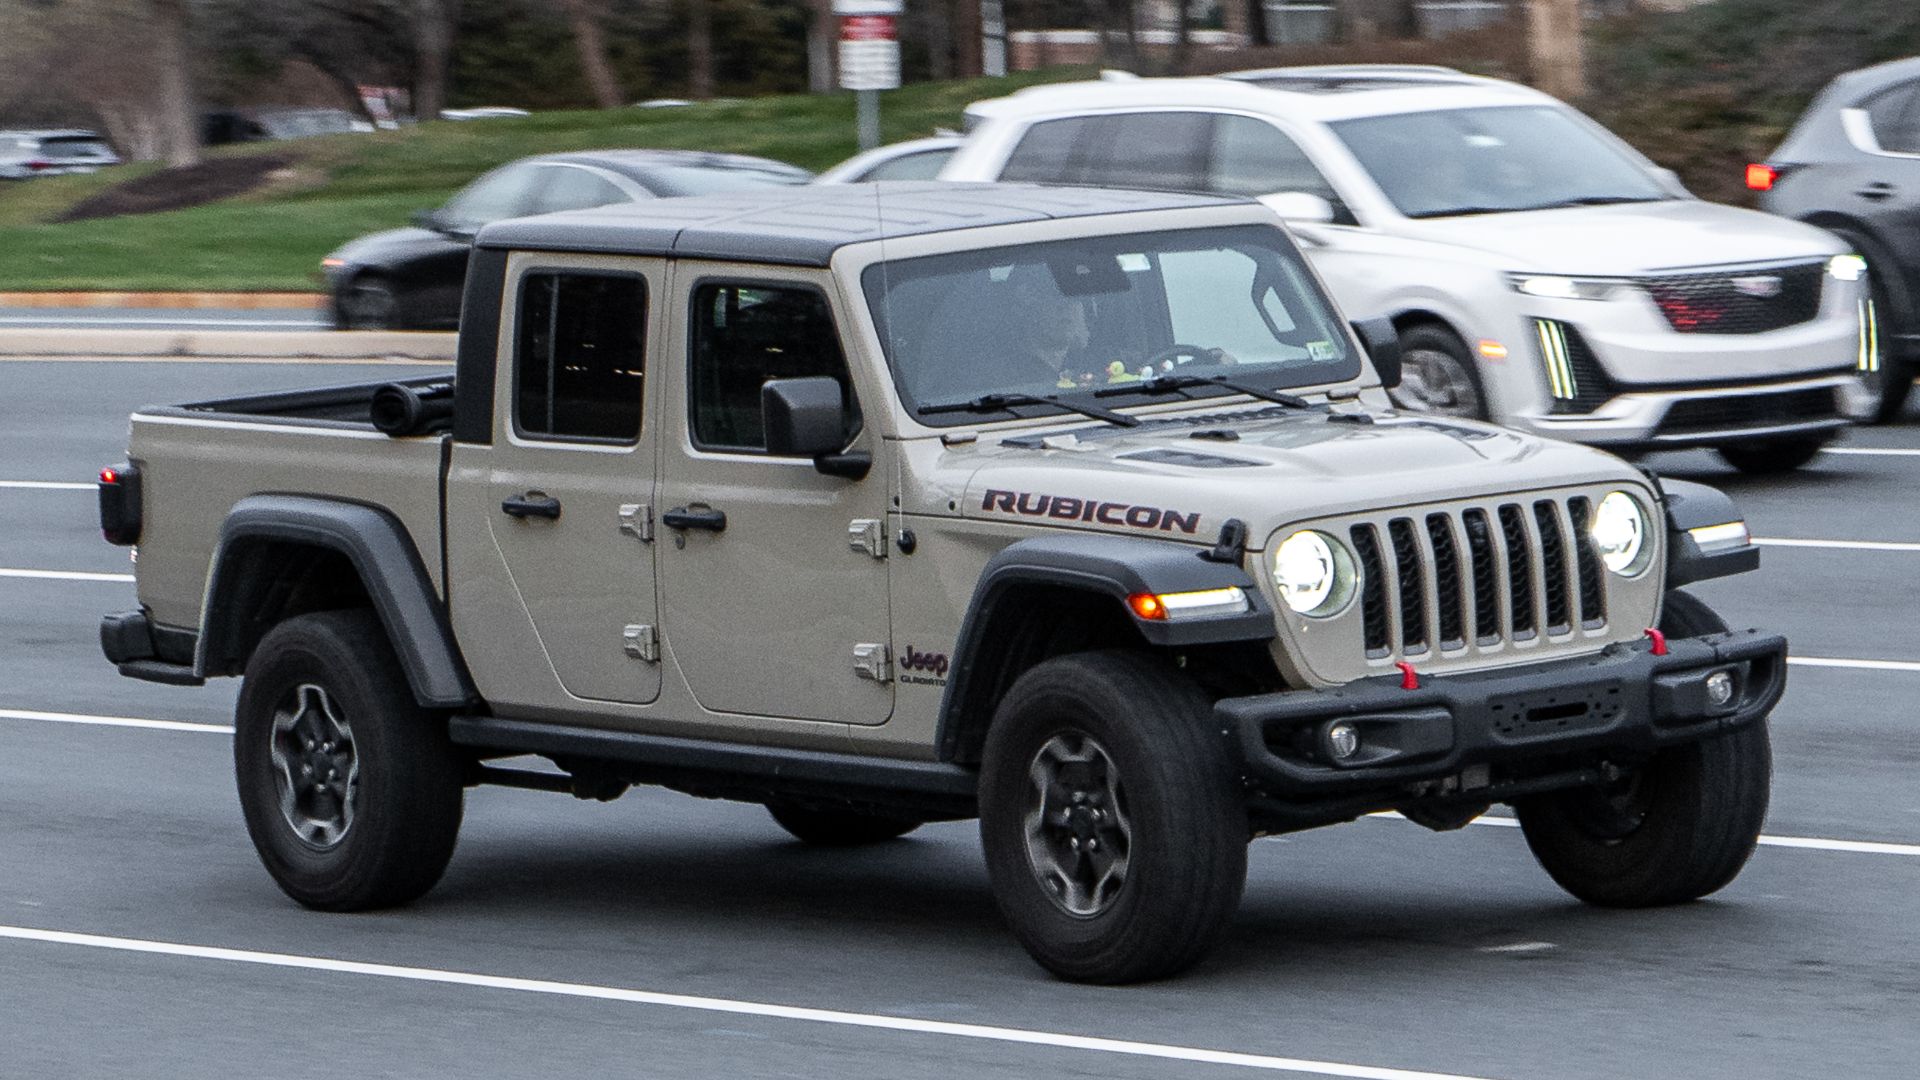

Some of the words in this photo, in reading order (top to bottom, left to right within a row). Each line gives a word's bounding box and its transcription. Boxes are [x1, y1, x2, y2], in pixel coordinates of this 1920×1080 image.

[981, 489, 1201, 534] RUBICON
[900, 645, 949, 677] Jeep
[900, 674, 947, 687] GLADIATO
